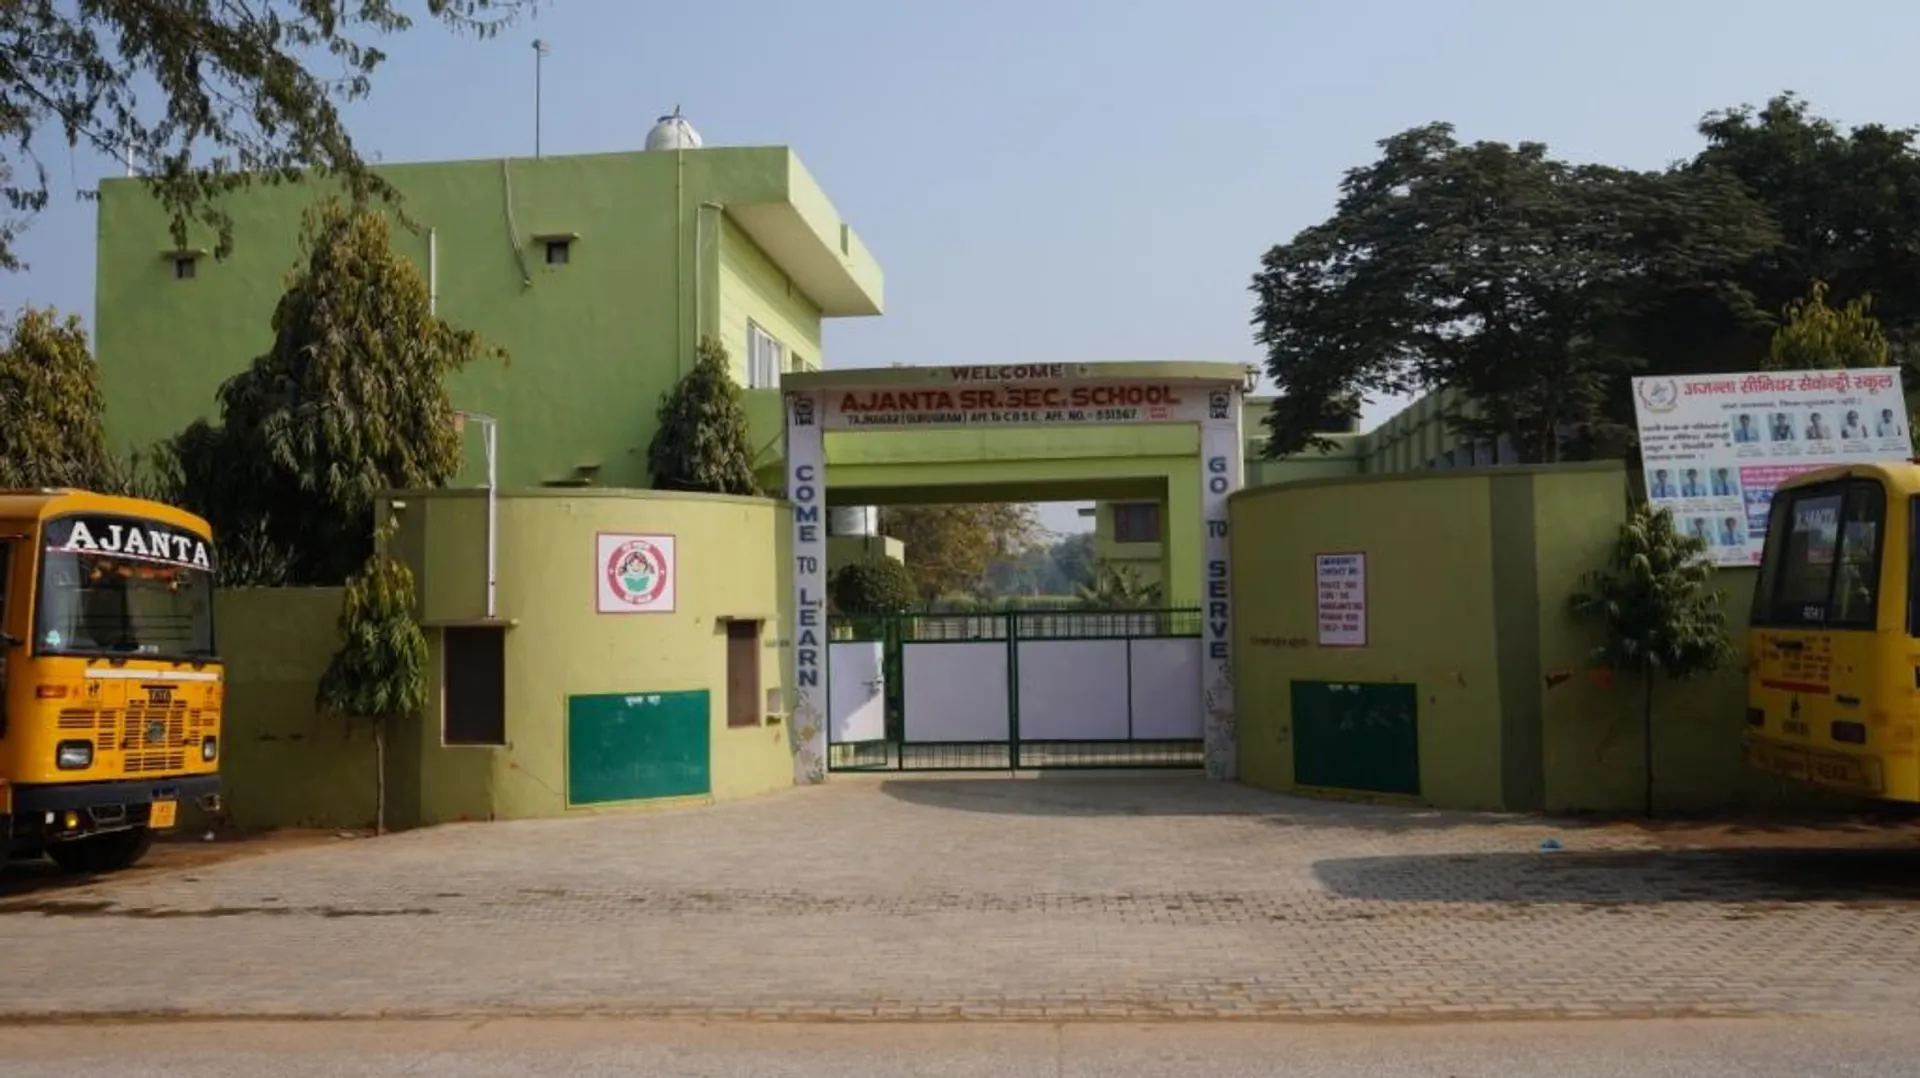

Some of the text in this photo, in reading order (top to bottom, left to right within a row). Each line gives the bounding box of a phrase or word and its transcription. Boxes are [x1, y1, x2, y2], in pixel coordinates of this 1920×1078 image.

[951, 363, 1063, 381] WELCOME
[840, 390, 954, 412] AJANTA
[1071, 385, 1182, 406] SCHOOL
[64, 520, 211, 568] AJANTA
[1207, 456, 1229, 660] GO TO SERVE
[795, 465, 819, 688] COME TO LEARN
